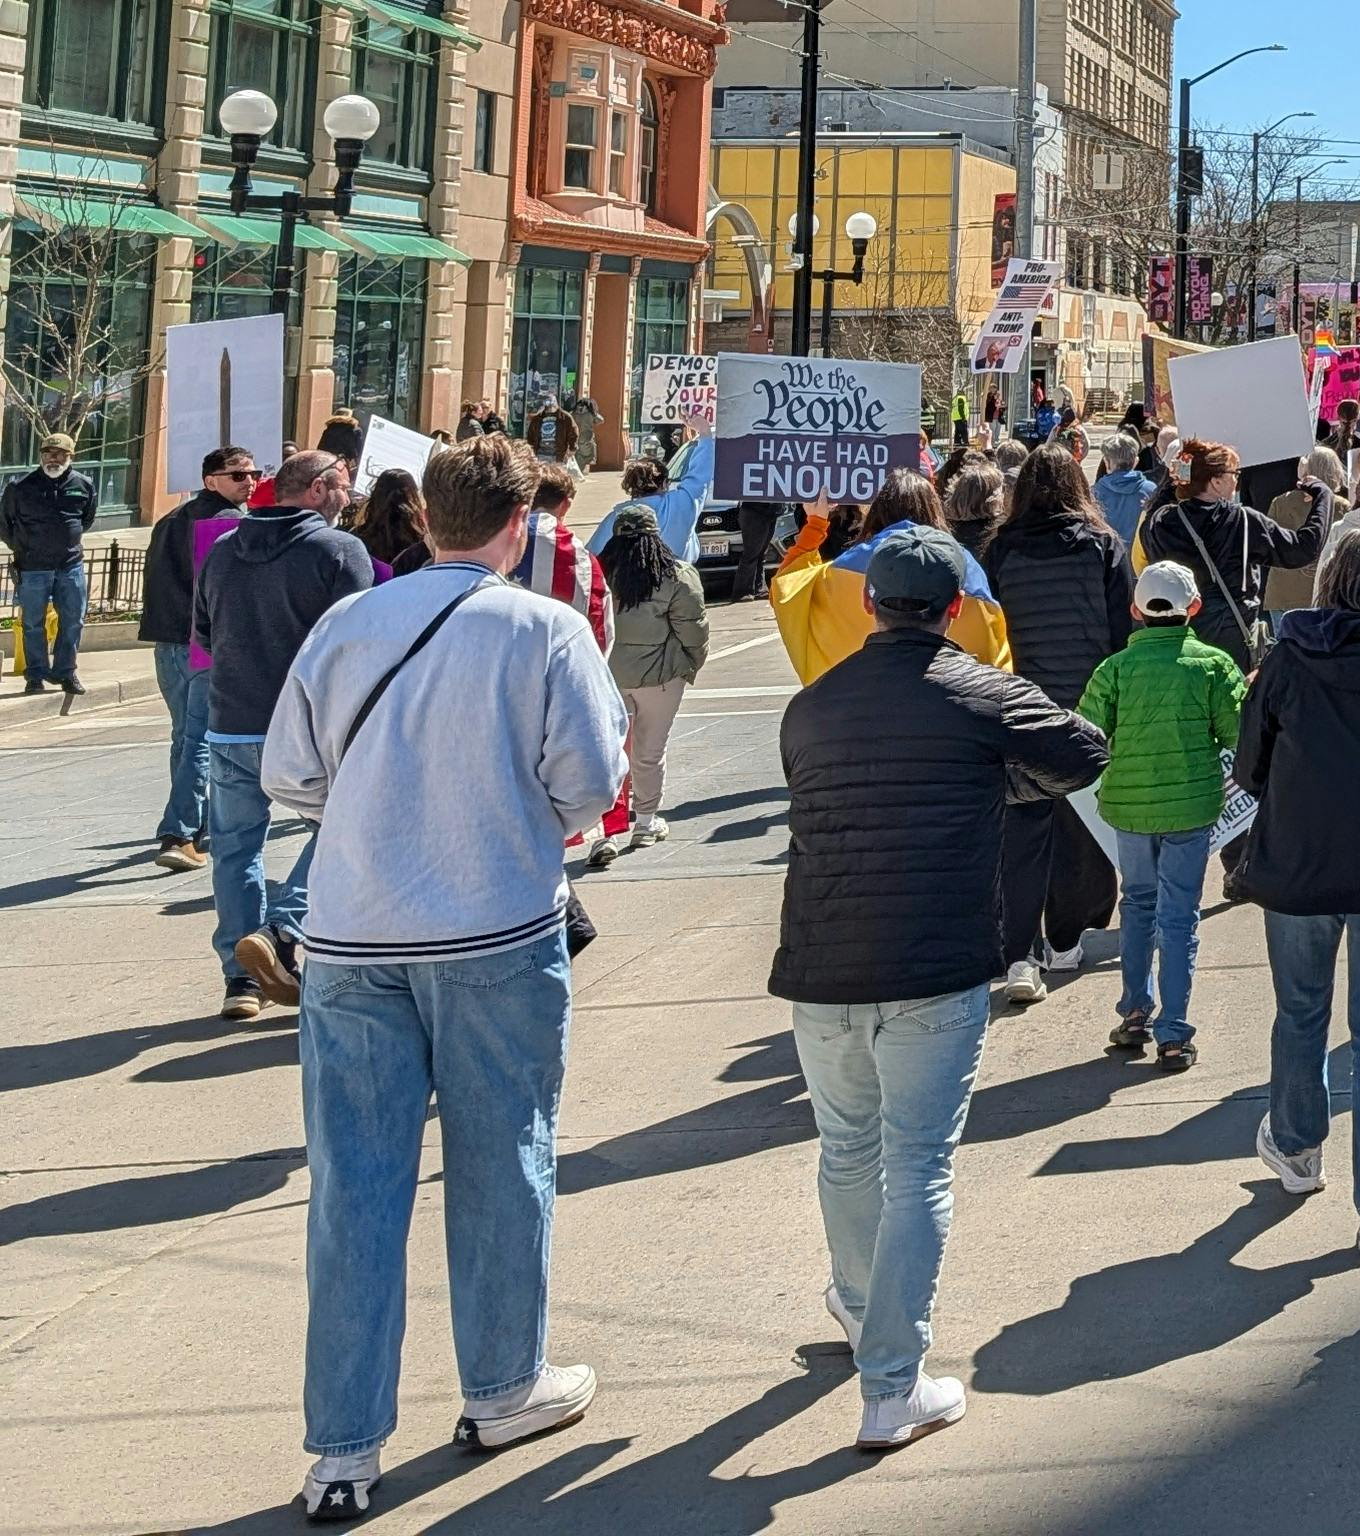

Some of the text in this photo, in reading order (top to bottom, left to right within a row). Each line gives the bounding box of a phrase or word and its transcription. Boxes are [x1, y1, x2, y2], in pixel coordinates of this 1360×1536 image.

[1010, 274, 1052, 284] AMERICA
[991, 324, 1024, 333] TRUMP
[782, 362, 857, 394] We the
[665, 388, 716, 404] YOUR
[752, 378, 888, 440] People
[758, 439, 889, 465] HAVE HAD
[1221, 793, 1254, 825] NEED
